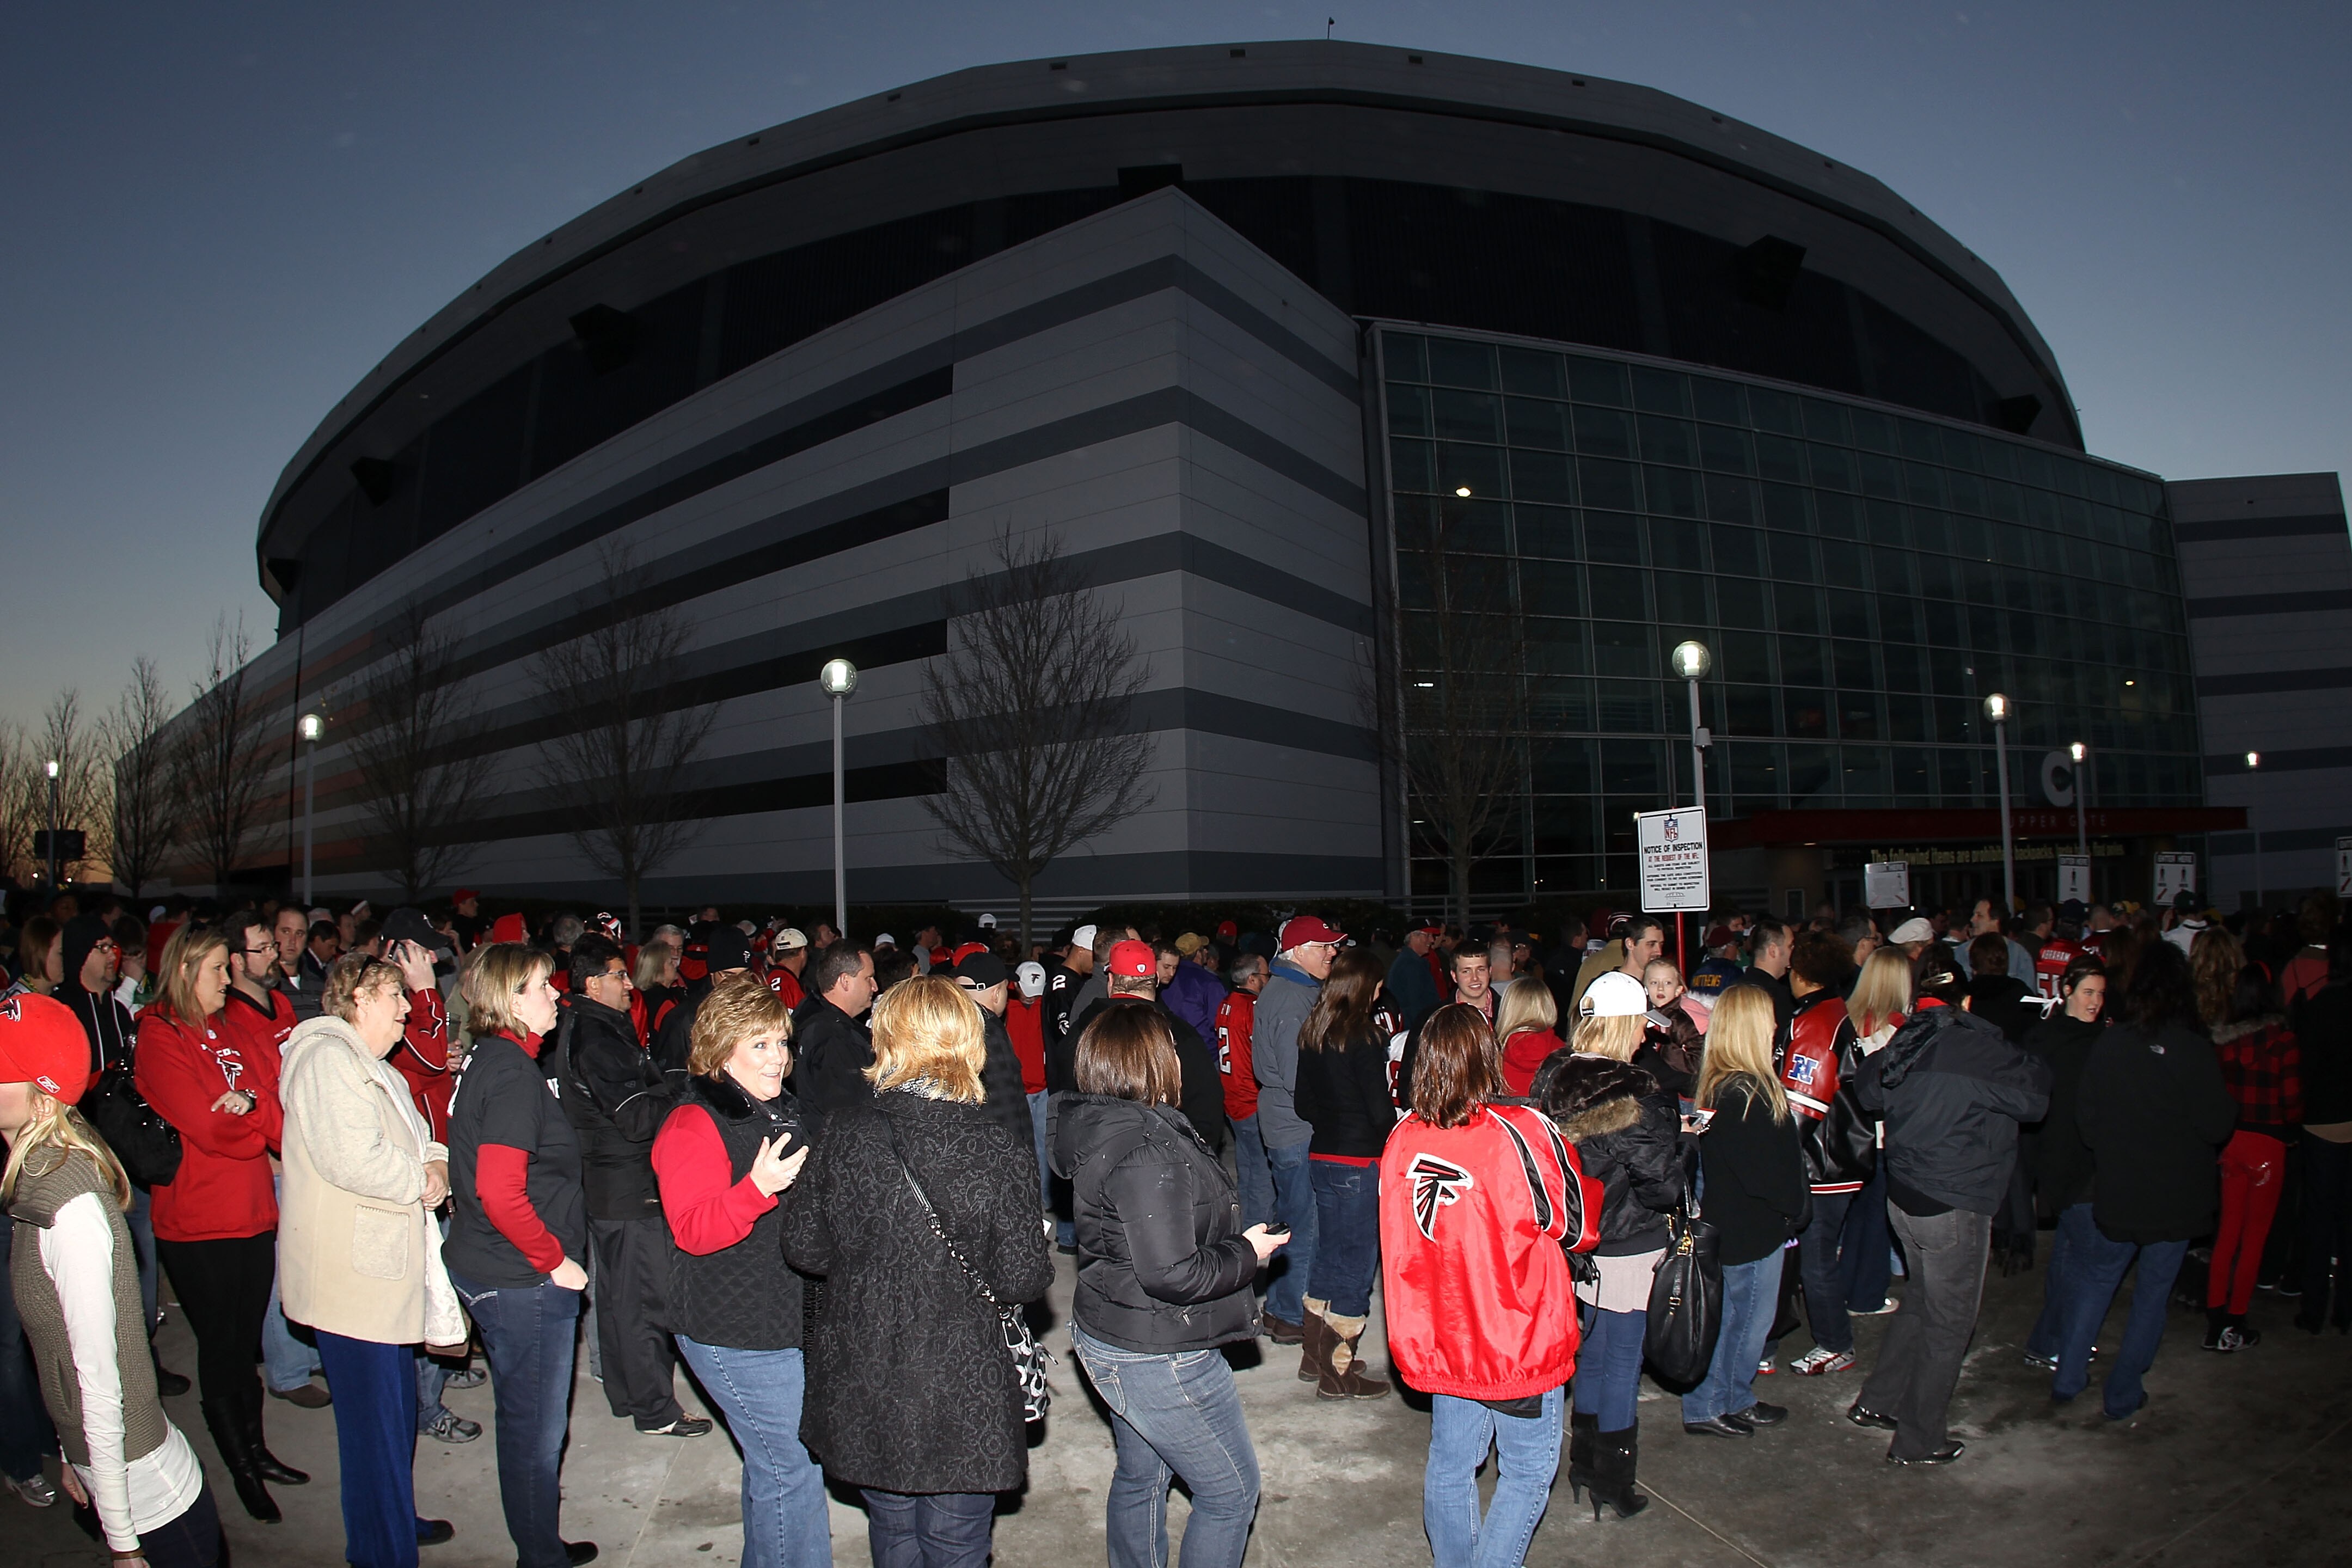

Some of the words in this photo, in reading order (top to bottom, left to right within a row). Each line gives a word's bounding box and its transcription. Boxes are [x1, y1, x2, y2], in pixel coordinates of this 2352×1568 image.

[2042, 751, 2073, 807] C
[2069, 814, 2107, 828] GTE
[1665, 828, 1678, 839] NFL
[1644, 845, 1662, 854] NOTICE
[1664, 844, 1670, 853] OF
[1673, 842, 1702, 852] INSPECTION
[771, 977, 781, 991] 2
[1052, 975, 1066, 991] 2
